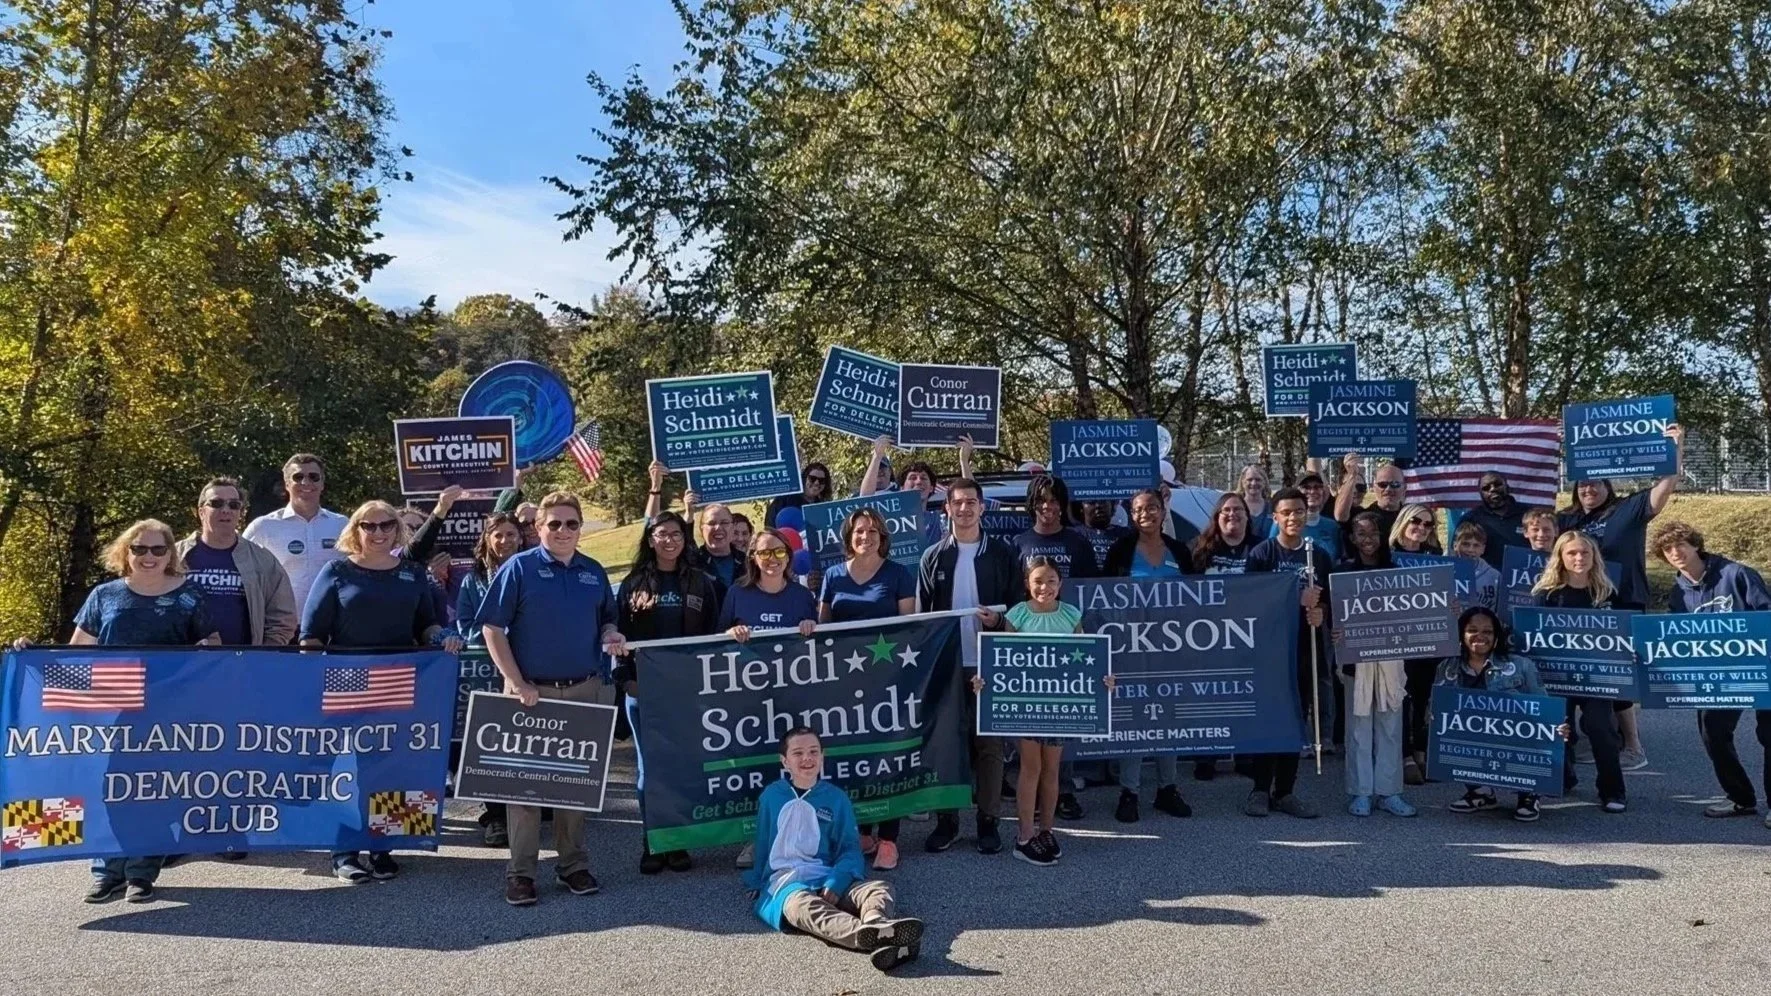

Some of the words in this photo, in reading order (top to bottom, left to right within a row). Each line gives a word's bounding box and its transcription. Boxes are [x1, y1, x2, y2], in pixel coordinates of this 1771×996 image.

[1273, 353, 1319, 370] Heidi
[835, 359, 888, 388] Heidi
[930, 376, 968, 389] Conor
[662, 386, 724, 410] Heidi
[907, 386, 992, 410] Curran
[1327, 384, 1396, 402] JASMINE
[824, 402, 846, 412] FOR
[1314, 401, 1410, 422] JACKSON
[1583, 402, 1653, 424] JASMINE
[665, 407, 762, 434] Schmidt
[902, 420, 938, 428] Democratic
[939, 420, 962, 428] Central
[962, 421, 996, 430] Committee
[1070, 425, 1138, 442] JASMINE
[1571, 418, 1668, 445] JACKSON
[410, 442, 502, 462] KITCHIN
[667, 442, 692, 450] FOR
[699, 435, 764, 448] DELEGATE
[1058, 442, 1152, 463] JACKSON
[1574, 448, 1618, 458] REGISTER
[1636, 445, 1666, 454] WILLS
[700, 478, 723, 486] FOR
[729, 470, 789, 483] DELEGATE
[889, 544, 919, 556] WILLS
[1354, 573, 1432, 597] JASMINE
[1483, 585, 1495, 598] 19
[1076, 579, 1227, 613] JASMINE
[1340, 591, 1448, 622] JACKSON
[760, 613, 783, 622] GET
[1536, 613, 1618, 631] JASMINE
[1345, 625, 1395, 637] REGISTER
[1416, 622, 1448, 631] WILLS
[1658, 618, 1748, 641] JASMINE
[1360, 648, 1402, 657] EXPERIENCE
[1522, 631, 1635, 653] JACKSON
[1644, 639, 1767, 665] JACKSON
[697, 638, 840, 695] Heidi
[993, 646, 1057, 668] Heidi
[1581, 663, 1593, 672] OF
[1599, 664, 1633, 674] WILLS
[1649, 673, 1706, 681] REGISTER
[1730, 672, 1767, 680] WILLS
[992, 671, 1096, 694] Schmidt
[1158, 682, 1184, 696] OF
[1191, 680, 1254, 695] WILLS
[1585, 686, 1619, 694] MATTERS
[992, 704, 1018, 712] FOR
[1026, 704, 1097, 713] DELEGATE
[1454, 693, 1540, 716] JASMINE
[512, 712, 568, 731] Conor
[701, 685, 924, 752] Schmidt
[1437, 712, 1556, 742] JACKSON
[4, 723, 225, 757] MARYLAND
[236, 722, 397, 756] DISTRICT
[409, 722, 441, 750] 31
[476, 723, 599, 762] Curran
[1168, 727, 1230, 739] MATTERS
[1439, 744, 1493, 758] REGISTER
[1497, 750, 1512, 760] OF
[1516, 754, 1552, 765] WILLS
[104, 770, 352, 803] DEMOCRATIC
[465, 766, 517, 778] Democratic
[518, 771, 550, 782] Central
[552, 774, 600, 786] Committee
[708, 771, 764, 795] FOR
[864, 777, 920, 796] District
[924, 771, 939, 784] 31
[1452, 769, 1499, 781] EXPERIENCE
[1500, 776, 1536, 786] MATTERS
[183, 803, 280, 834] CLUB
[692, 803, 721, 820] Get
